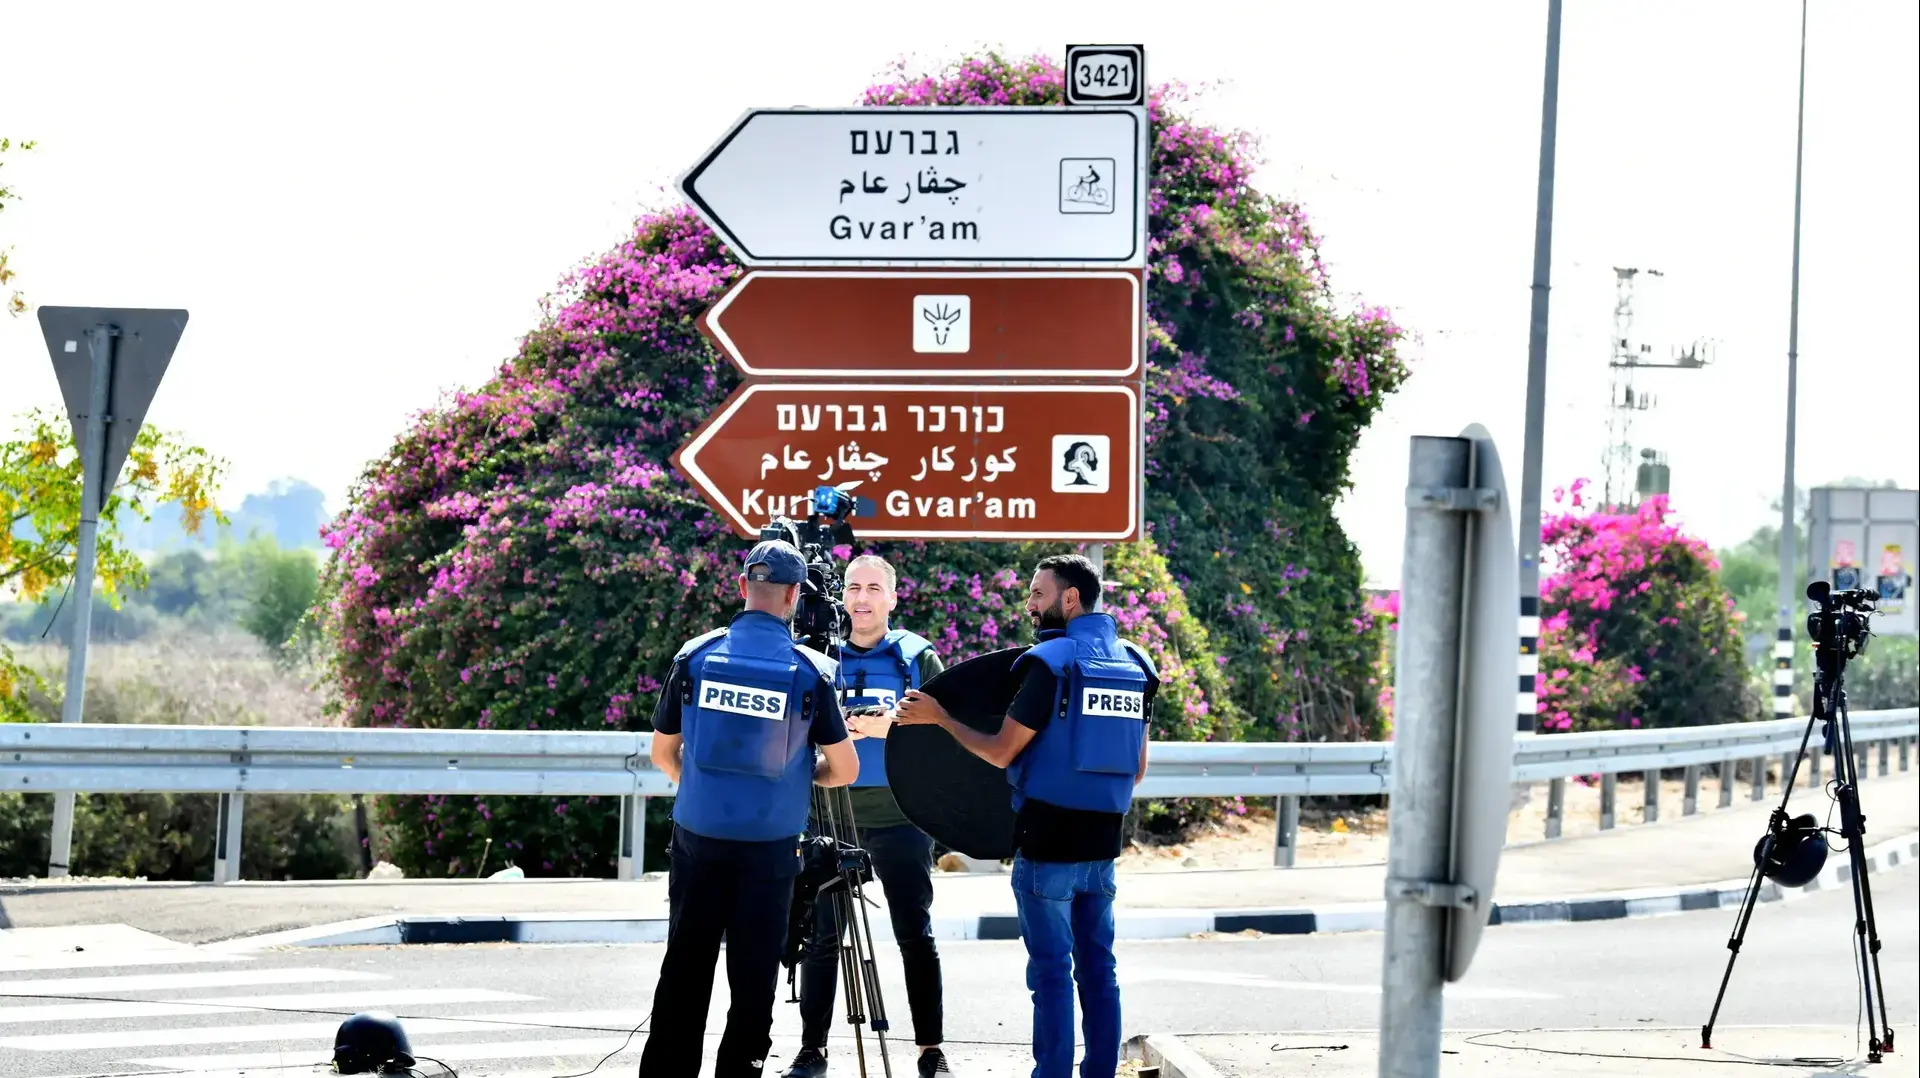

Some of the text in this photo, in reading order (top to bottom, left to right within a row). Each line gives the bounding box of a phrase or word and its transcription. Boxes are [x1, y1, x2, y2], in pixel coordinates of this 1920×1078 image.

[1080, 64, 1128, 88] 3421
[849, 130, 960, 155] גברעם
[776, 404, 1005, 433] כורכר גברעם
[705, 687, 781, 714] PRESS
[1088, 693, 1141, 713] PRESS
